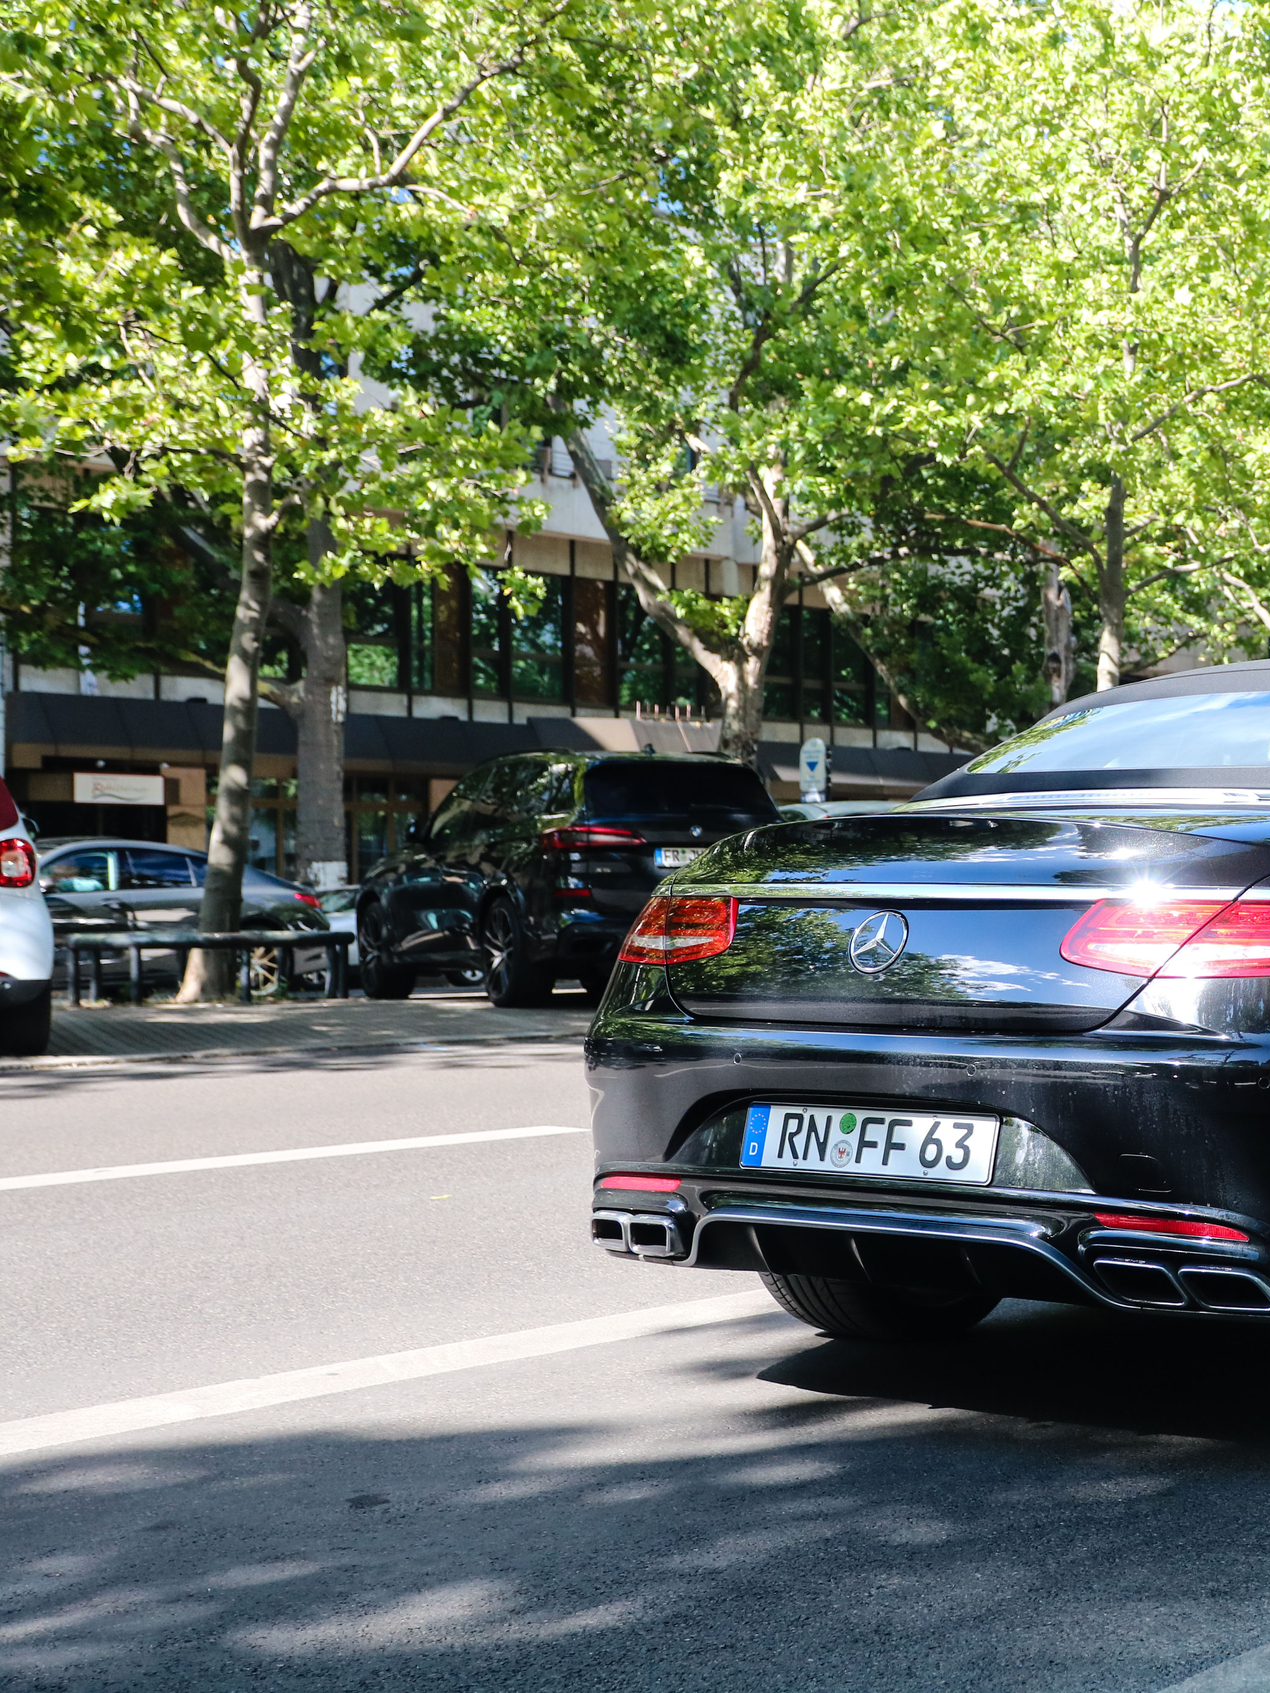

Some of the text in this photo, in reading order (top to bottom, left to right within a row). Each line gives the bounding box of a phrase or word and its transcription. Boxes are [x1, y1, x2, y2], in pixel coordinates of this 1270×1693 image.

[664, 849, 680, 862] FR
[777, 1112, 974, 1170] RN FF 63
[749, 1142, 758, 1156] D
